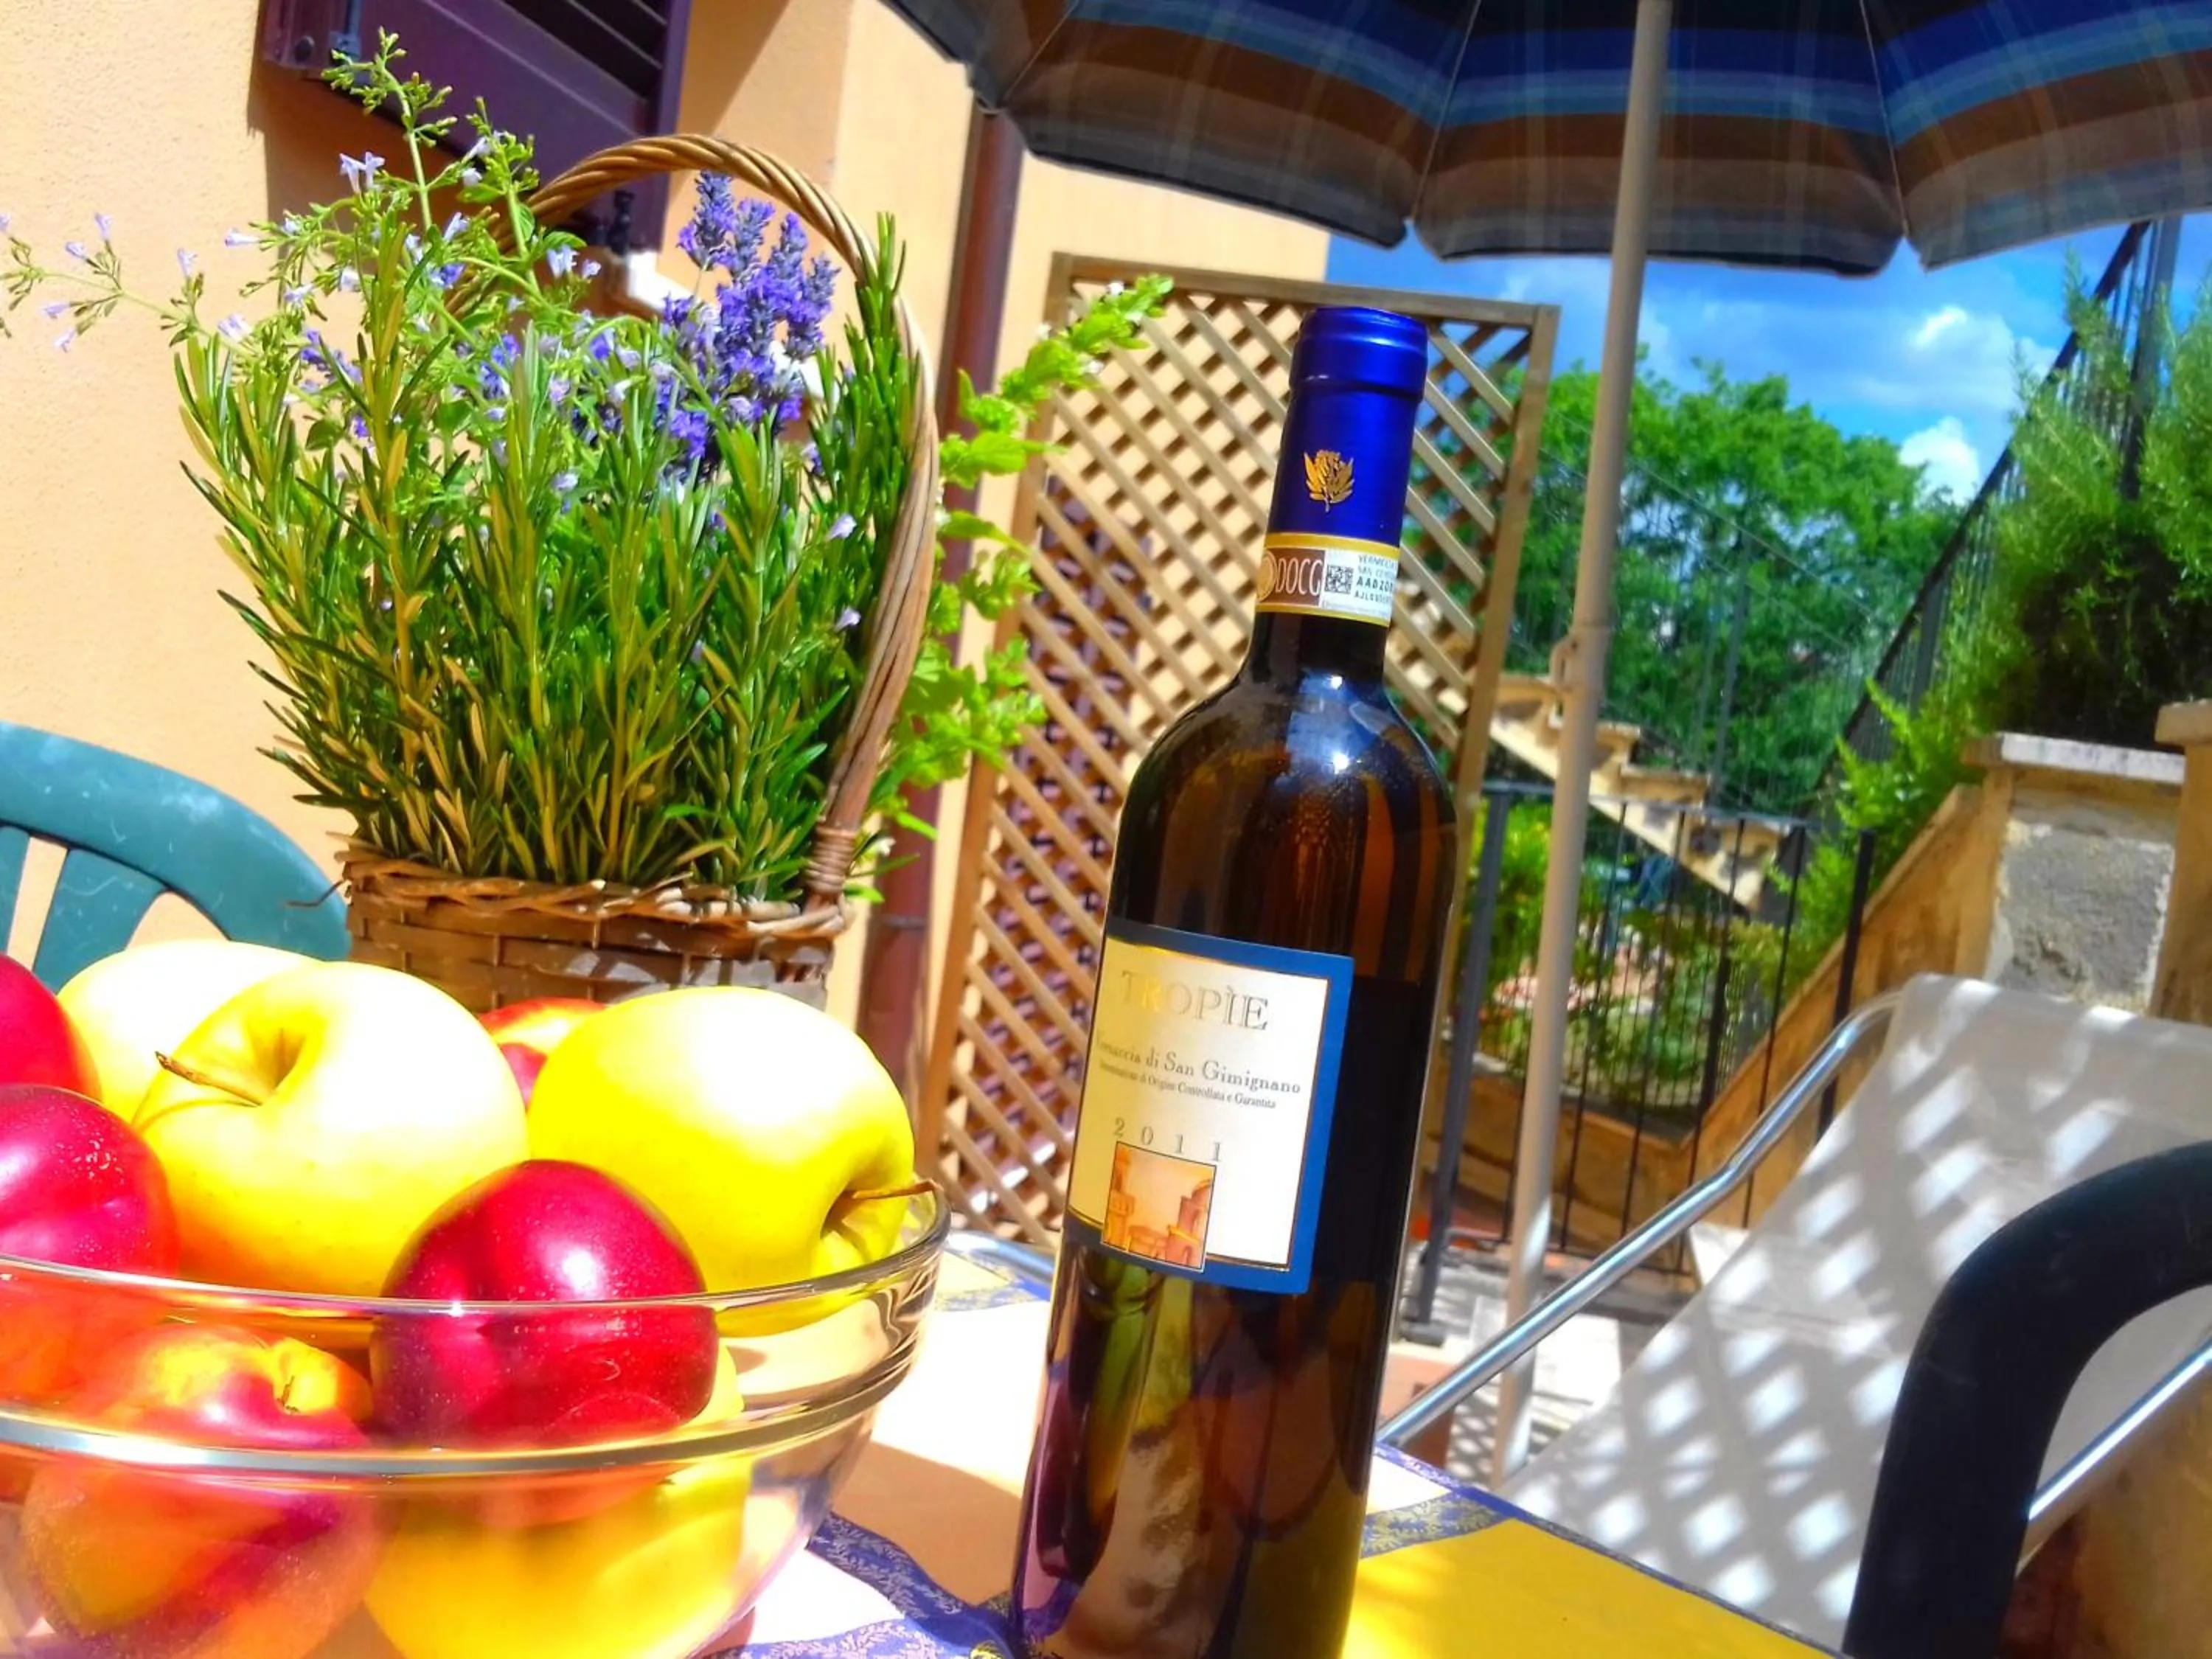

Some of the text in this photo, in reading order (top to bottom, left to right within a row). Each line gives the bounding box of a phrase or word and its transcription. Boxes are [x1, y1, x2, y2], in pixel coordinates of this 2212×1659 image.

[1275, 557, 1324, 597] DOCG
[1145, 1046, 1159, 1068] di
[1164, 1050, 1194, 1077] San
[1202, 1060, 1301, 1093] Gimignano
[1234, 1092, 1277, 1109] Garantita
